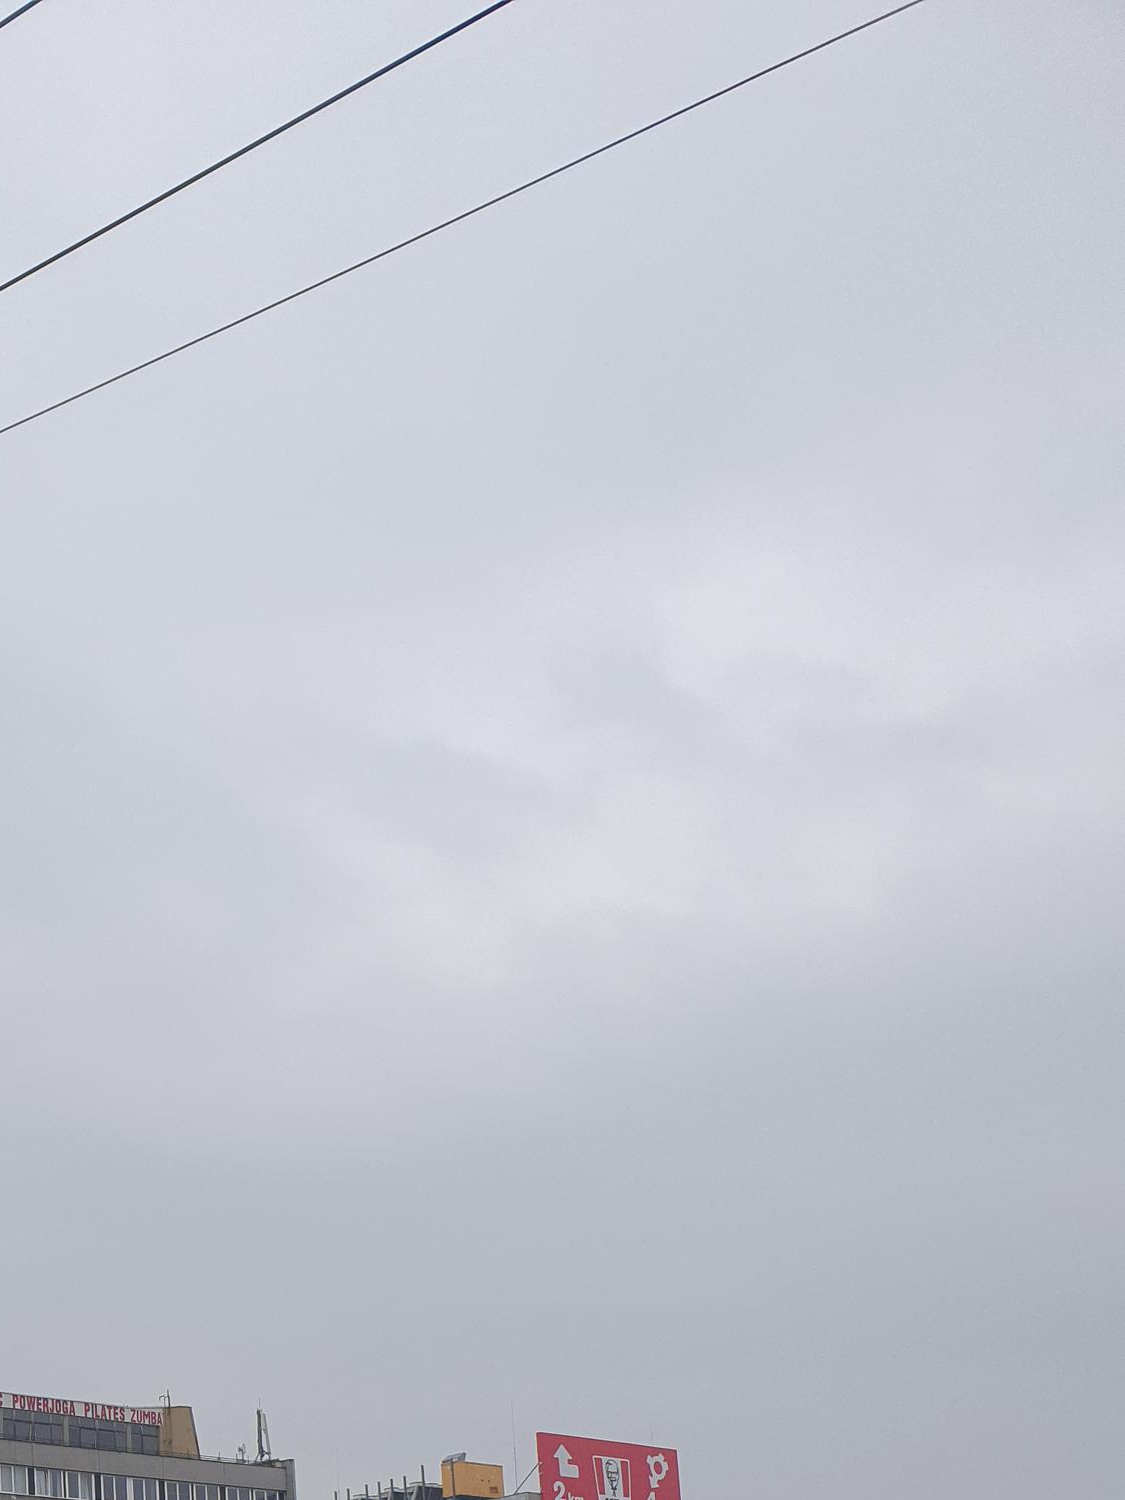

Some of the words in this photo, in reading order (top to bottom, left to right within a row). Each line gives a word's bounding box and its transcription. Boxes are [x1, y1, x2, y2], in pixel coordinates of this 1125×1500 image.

[11, 1393, 76, 1416] POWERJOGA
[83, 1403, 125, 1422] PILATES
[130, 1408, 163, 1426] ZUMBA
